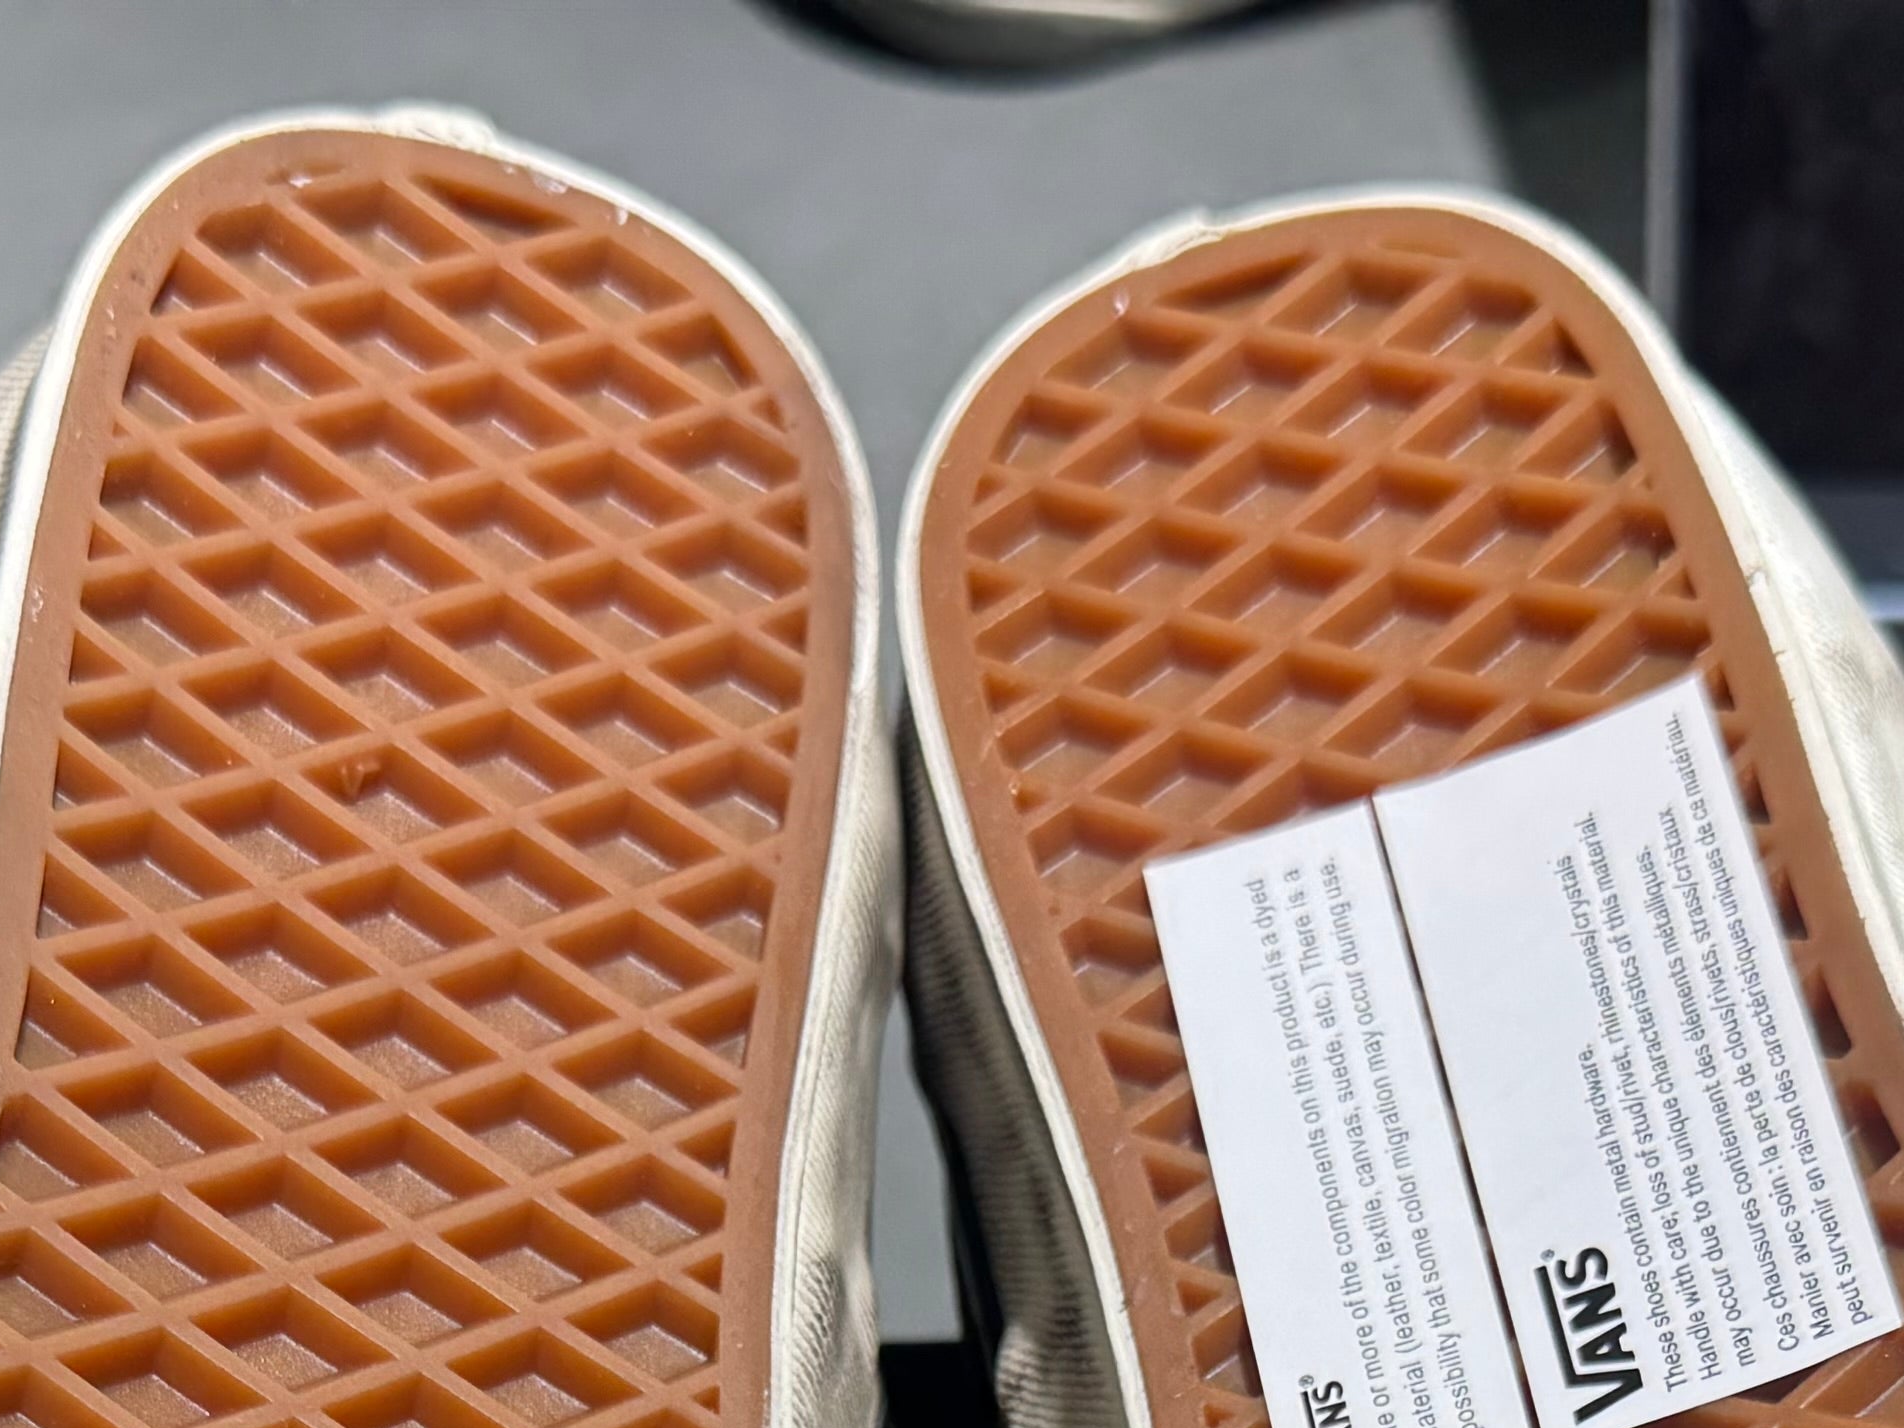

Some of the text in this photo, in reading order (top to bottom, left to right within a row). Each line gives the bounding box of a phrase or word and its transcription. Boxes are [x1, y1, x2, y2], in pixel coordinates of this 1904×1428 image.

[1242, 876, 1278, 929] dyed
[1282, 866, 1301, 883] a
[1284, 886, 1309, 912] is
[1318, 856, 1343, 900] use.
[1259, 930, 1280, 947] a
[1260, 947, 1286, 972] is
[1293, 912, 1324, 977] There
[1328, 899, 1361, 967] during
[1265, 970, 1311, 1052] product
[1305, 980, 1337, 1029] etc.)
[1344, 969, 1376, 1026] occur
[1664, 711, 1874, 1326] peut survenir en raison des caractéristiques uniques de ce matériau.
[1700, 942, 1748, 1061] clous/rivets,
[1286, 1052, 1315, 1095] this
[1322, 1031, 1355, 1104] suede,
[1360, 1029, 1388, 1073] may
[1731, 1061, 1756, 1088] de
[1299, 1096, 1322, 1125] on
[1572, 810, 1757, 1367] may occur due to the unique characteristics of this material.
[1635, 844, 1801, 1352] Ces chaussures contiennent des éléments métalliques.
[1743, 1087, 1779, 1144] perte
[1342, 1104, 1377, 1188] canvas,
[1371, 1074, 1412, 1170] migration
[1552, 854, 1723, 1381] Handle with care; loss of stud/rivet, rhinestones/crystals
[1757, 1142, 1780, 1167] la
[1305, 1125, 1354, 1257] components
[1395, 1173, 1425, 1224] color
[1577, 1042, 1689, 1393] These shoes contain metal hardware.
[1767, 1173, 1797, 1218] soin
[1361, 1189, 1396, 1263] textile,
[1410, 1225, 1440, 1284] some
[1783, 1218, 1812, 1266] avec
[1338, 1259, 1364, 1297] the
[1421, 1283, 1452, 1329] that
[1798, 1270, 1835, 1340] Manier
[1341, 1297, 1370, 1320] of
[1380, 1263, 1424, 1354] (leather,
[1536, 1248, 1643, 1424] VANS
[1354, 1323, 1385, 1381] more
[1368, 1384, 1391, 1408] or
